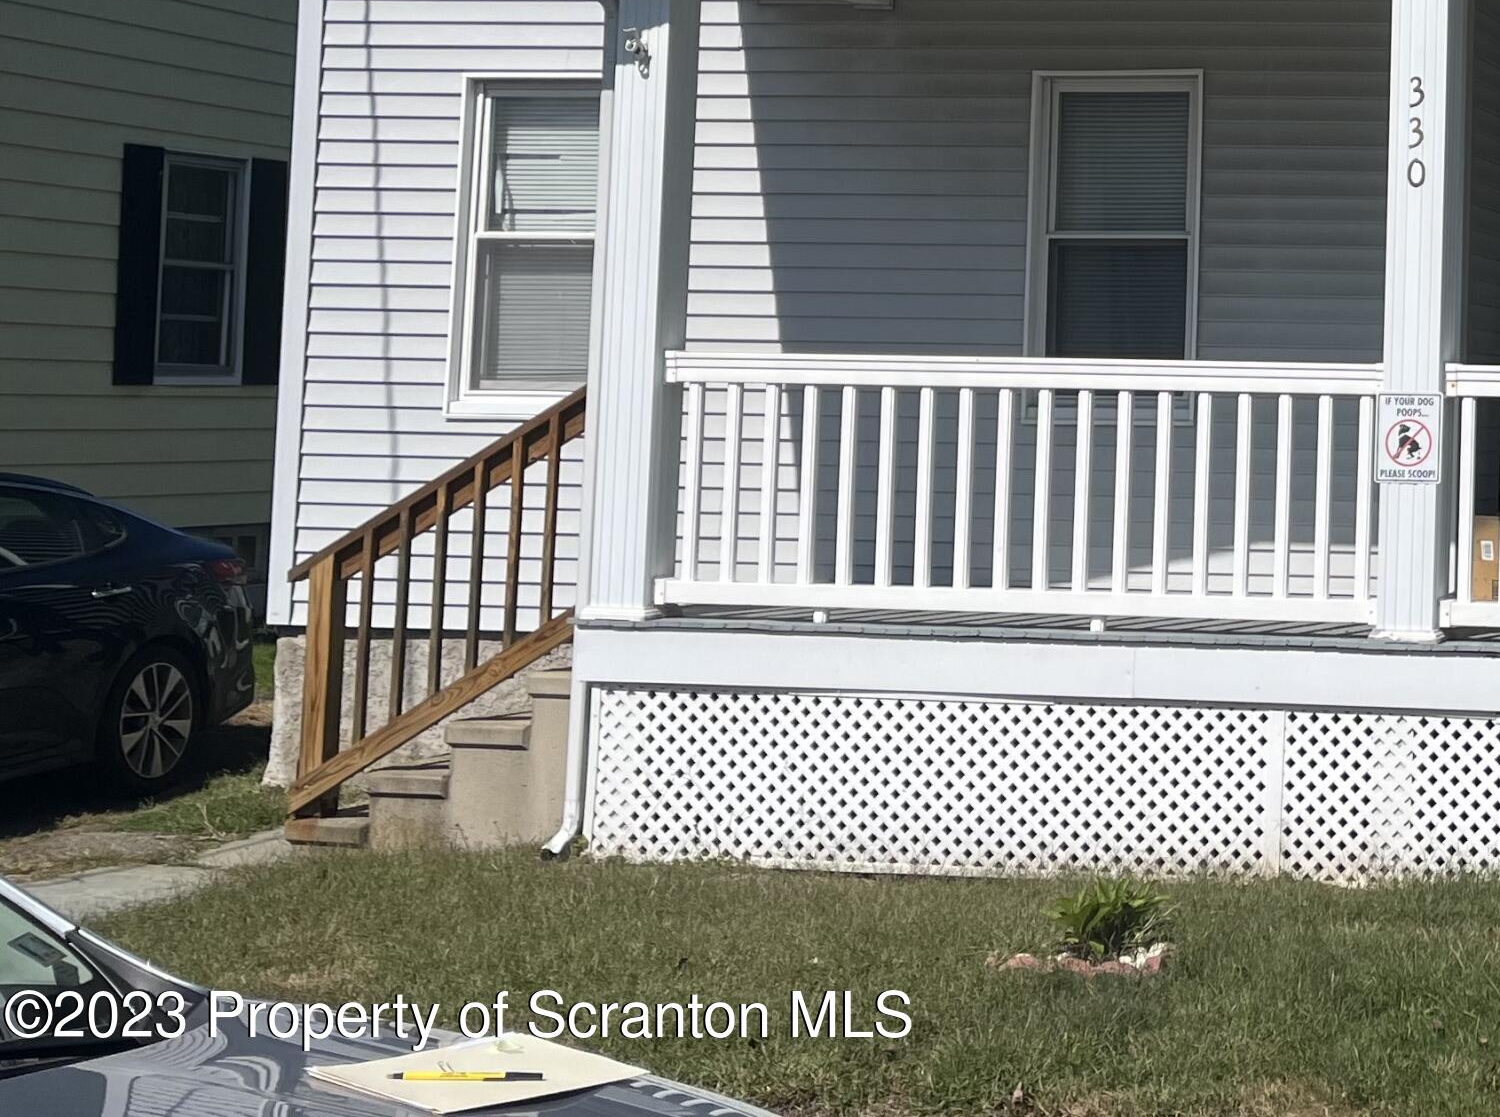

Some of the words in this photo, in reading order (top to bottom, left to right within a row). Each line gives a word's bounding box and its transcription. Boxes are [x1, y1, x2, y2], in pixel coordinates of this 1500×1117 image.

[1407, 76, 1425, 188] 330
[1385, 397, 1392, 405] IF
[1394, 397, 1415, 406] YOUR
[1417, 398, 1434, 406] DOG
[1380, 469, 1406, 478] PLEASE
[1408, 469, 1436, 478] SCOOP!
